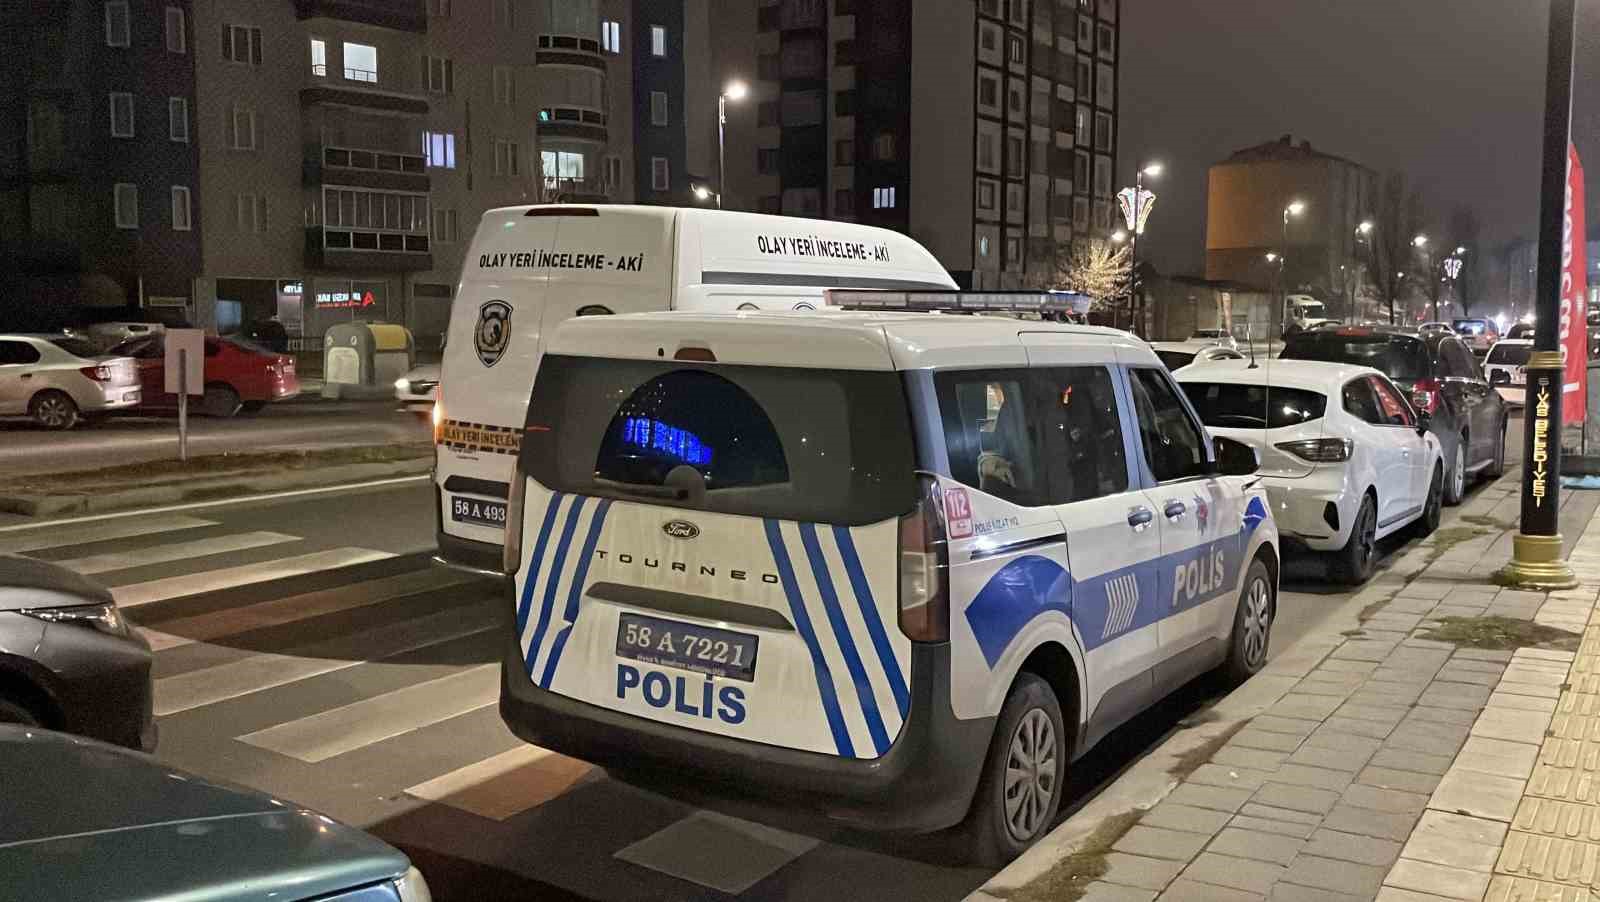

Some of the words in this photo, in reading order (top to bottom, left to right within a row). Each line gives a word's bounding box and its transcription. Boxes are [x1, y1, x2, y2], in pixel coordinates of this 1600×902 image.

[479, 252, 507, 268] OLAY
[509, 249, 537, 268] YERİ
[537, 249, 605, 270] İNCELEME
[616, 252, 644, 272] AKİ
[758, 235, 786, 254] OLAY
[789, 234, 816, 256] YERİ
[815, 235, 867, 260] İNCELEME
[874, 242, 890, 262] AKİ
[455, 500, 469, 516] 58
[471, 503, 481, 518] A
[945, 493, 968, 518] 112
[668, 523, 691, 536] Ford
[596, 550, 779, 585] TOURNEO
[1172, 544, 1225, 608] POLİS
[625, 623, 652, 648] 58
[656, 631, 676, 654] A
[682, 634, 744, 667] 7221
[616, 663, 747, 725] POLİS
